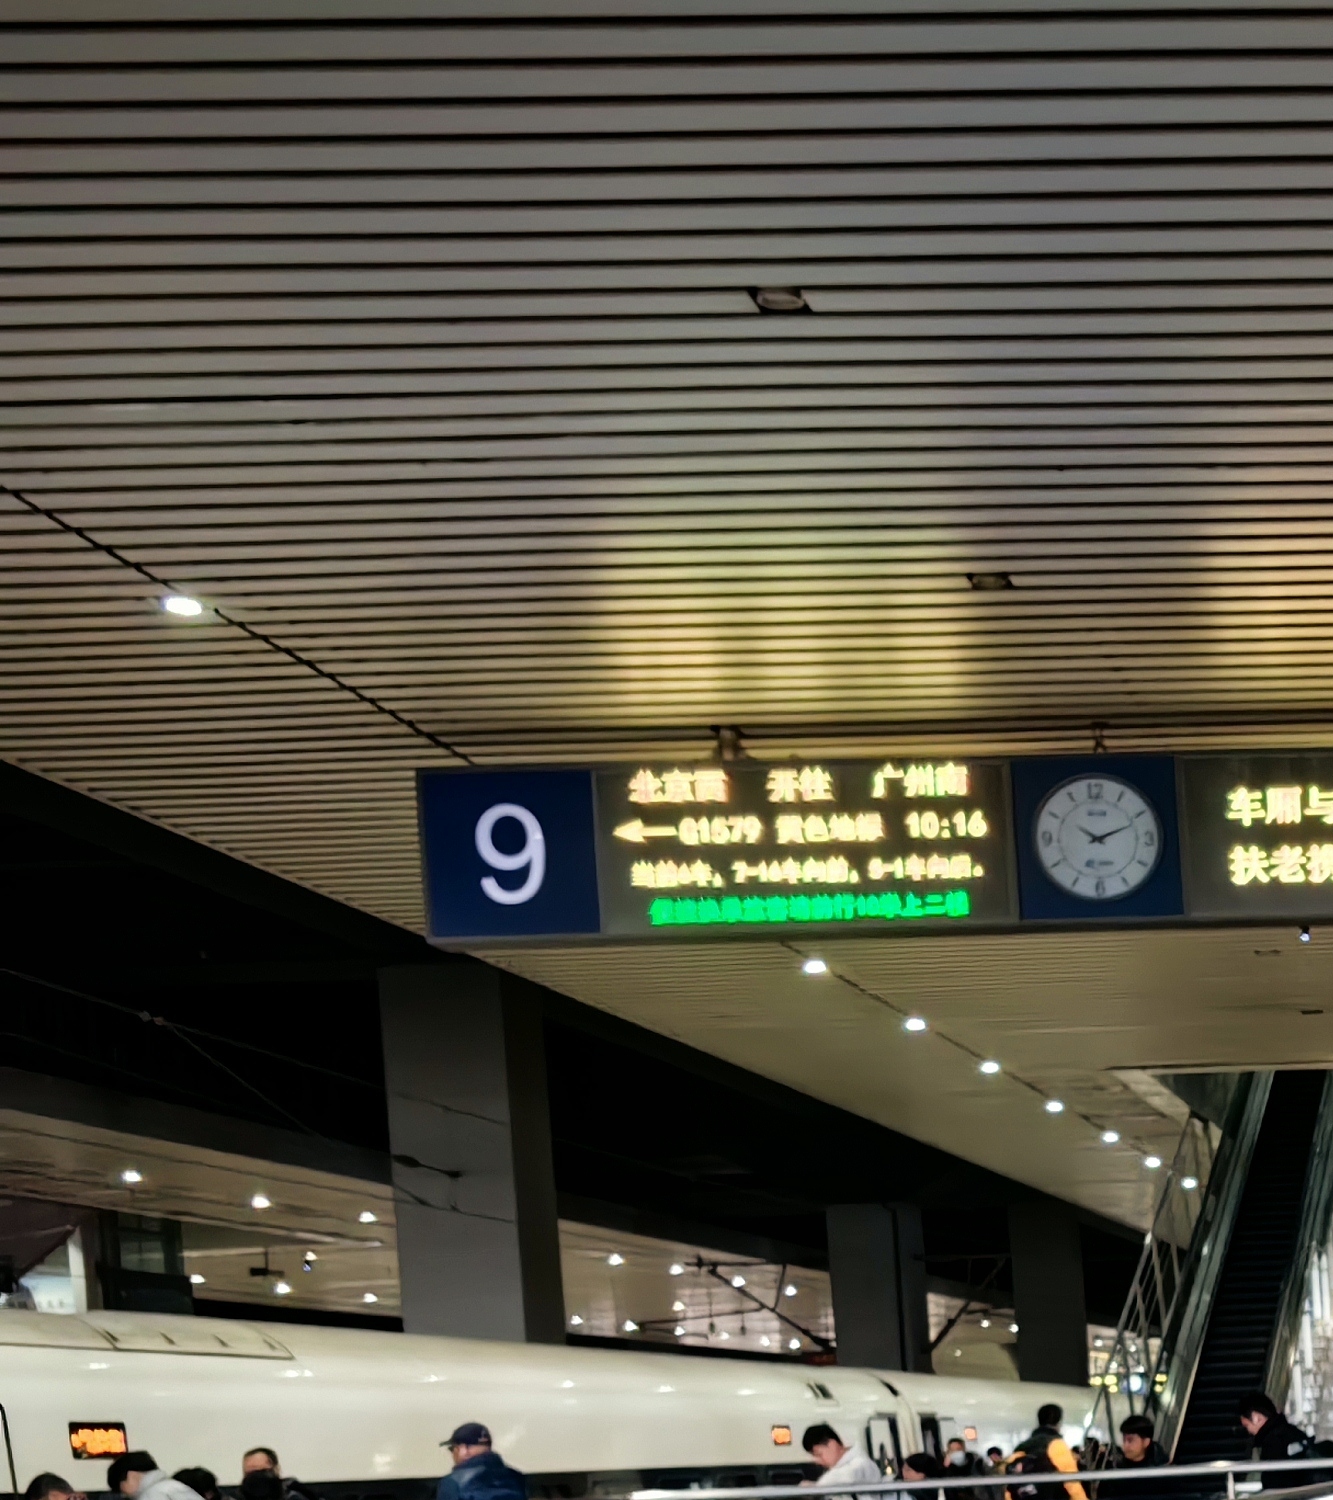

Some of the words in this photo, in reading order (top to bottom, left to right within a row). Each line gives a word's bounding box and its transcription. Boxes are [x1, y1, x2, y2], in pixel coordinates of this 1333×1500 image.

[628, 768, 730, 803] 北京西
[766, 766, 834, 803] 开往
[871, 762, 968, 799] 广州南
[905, 810, 989, 839] 10:16
[474, 802, 547, 905] 9
